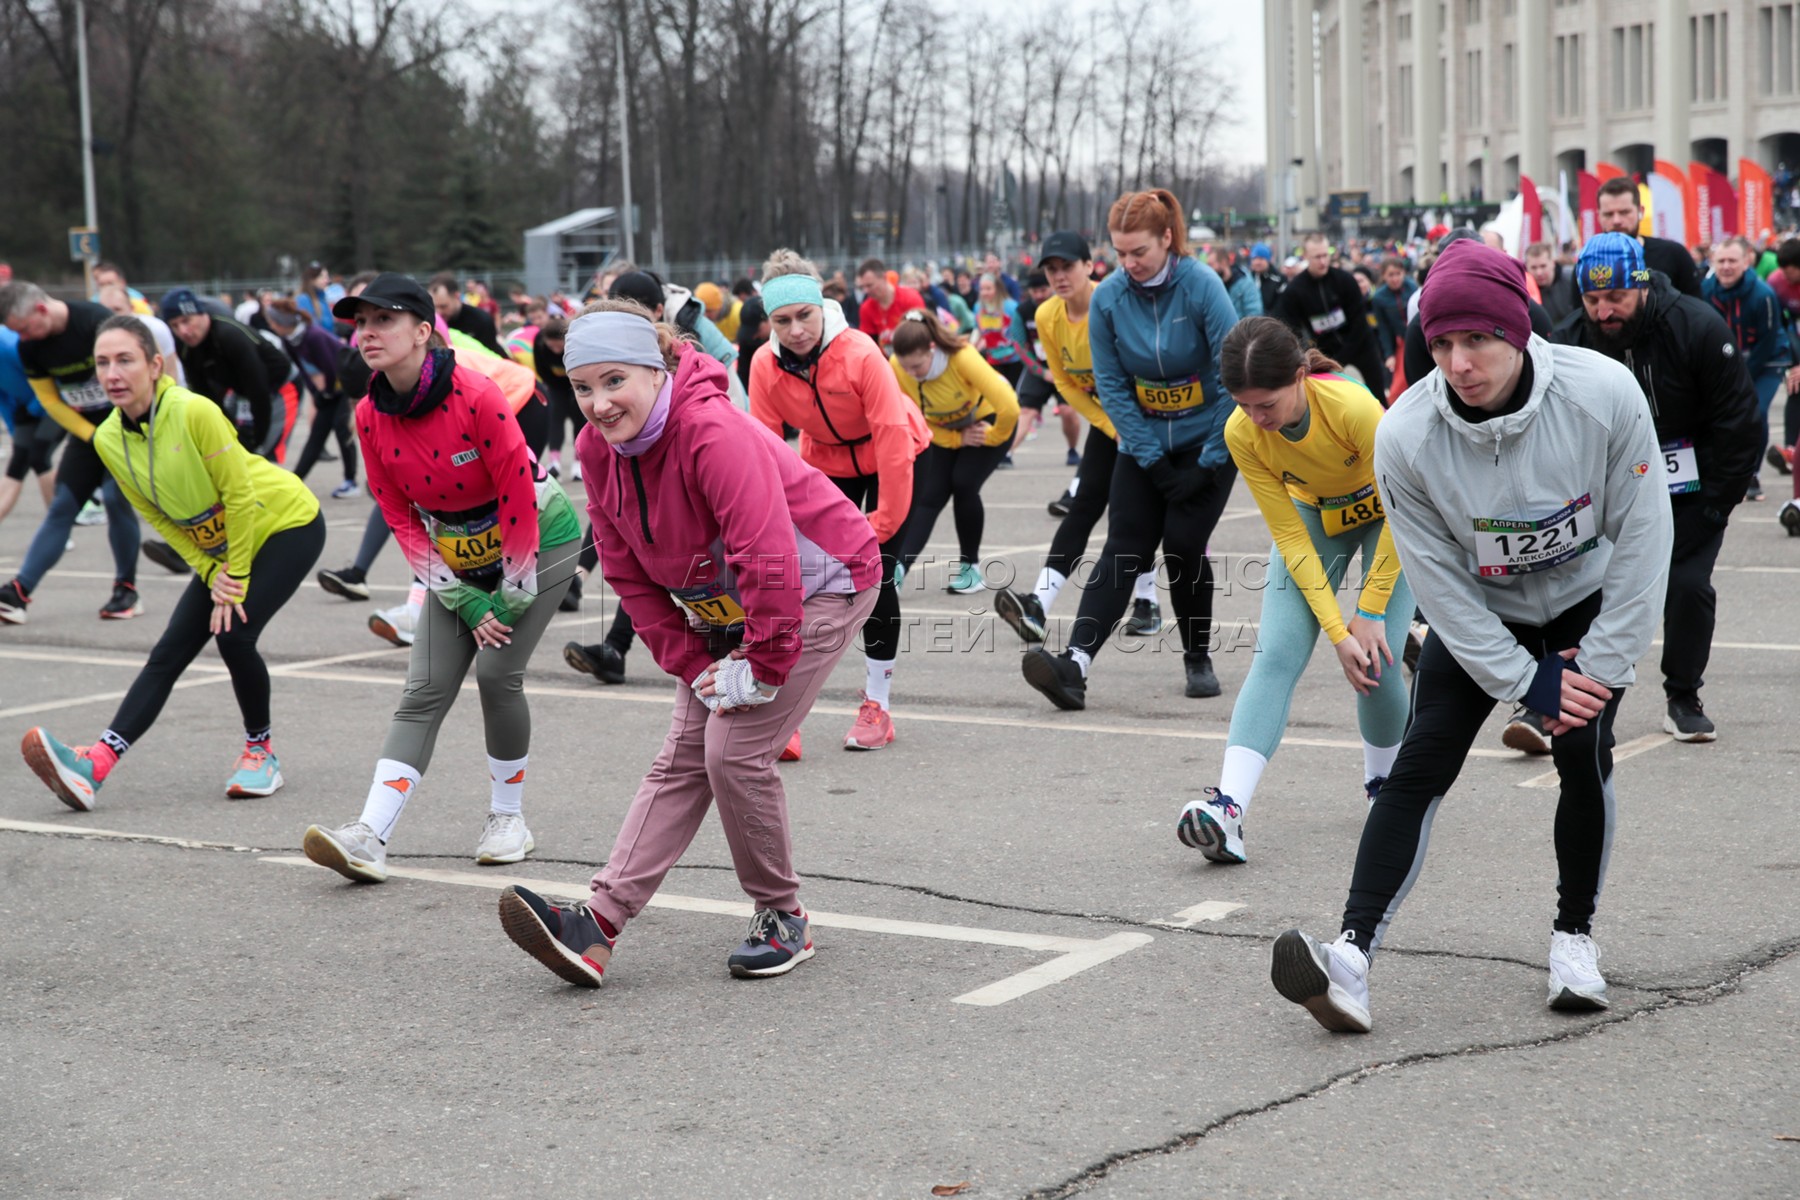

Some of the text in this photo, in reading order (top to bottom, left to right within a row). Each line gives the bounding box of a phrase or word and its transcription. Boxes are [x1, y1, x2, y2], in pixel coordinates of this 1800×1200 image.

[1144, 385, 1194, 405] 5057
[1491, 508, 1572, 530] АПРЕЛЬ 7.04.2024
[455, 530, 502, 560] 404
[1494, 516, 1579, 557] 1221
[1507, 541, 1574, 564] АЛЕКСАНДР
[1490, 566, 1503, 576] D
[690, 599, 729, 618] 17
